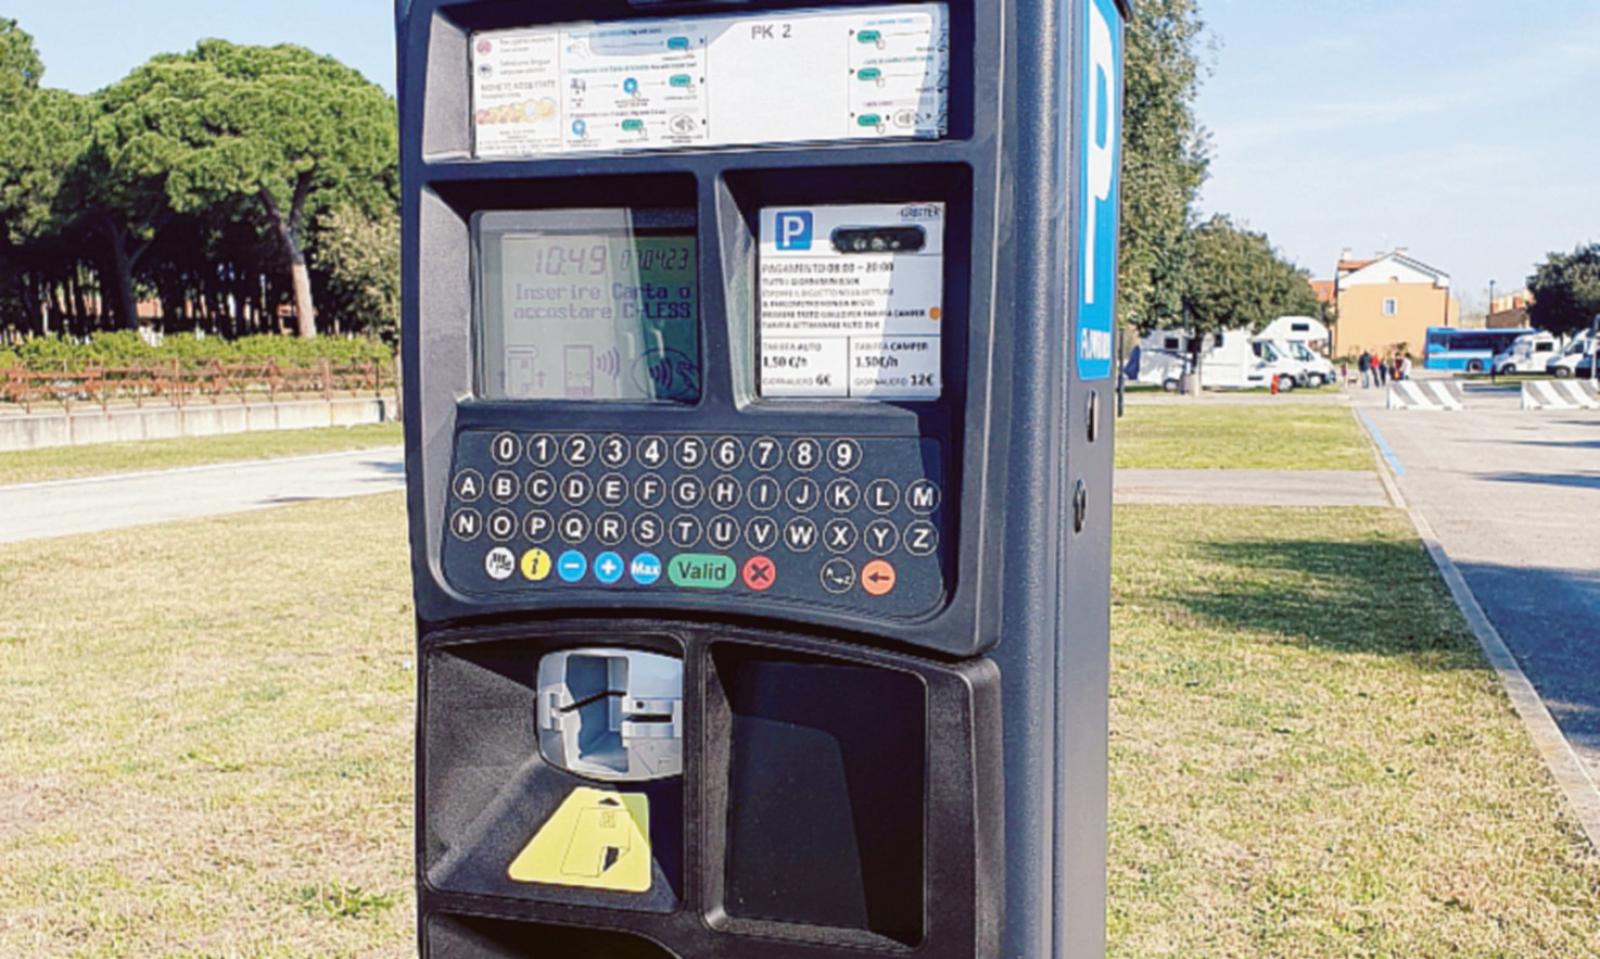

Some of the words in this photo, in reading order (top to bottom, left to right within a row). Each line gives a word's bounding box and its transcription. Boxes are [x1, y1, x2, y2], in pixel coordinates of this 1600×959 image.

[751, 24, 774, 40] PK
[782, 23, 792, 39] 2
[1084, 0, 1115, 305] P
[783, 216, 805, 247] P
[515, 283, 601, 301] Inserire
[612, 281, 669, 300] Carta
[678, 286, 691, 300] o
[513, 303, 613, 320] accostare
[623, 302, 692, 320] C-LESS
[890, 342, 928, 351] CAMPER
[815, 374, 831, 385] 6€
[910, 375, 934, 386] 12€
[536, 438, 547, 461] 1
[571, 439, 586, 461] 2
[607, 439, 623, 462] 3
[644, 440, 660, 463] 4
[682, 441, 697, 463] 5
[719, 441, 735, 465] 6
[758, 442, 774, 465] 7
[797, 442, 812, 466] 8
[837, 443, 852, 467] 9
[460, 476, 476, 495] A
[496, 478, 511, 496] B
[533, 479, 548, 498] C
[569, 479, 584, 498] D
[605, 480, 621, 499] E
[643, 481, 657, 500] F
[679, 482, 696, 501] G
[717, 483, 734, 502] H
[760, 484, 767, 503] I
[796, 485, 809, 504] J
[835, 485, 851, 506] K
[876, 487, 890, 506] L
[913, 487, 933, 507] M
[458, 515, 474, 533] N
[494, 516, 511, 535] O
[531, 517, 546, 535] P
[565, 518, 583, 538] Q
[603, 519, 619, 539] R
[640, 520, 655, 539] S
[678, 521, 693, 541] T
[715, 522, 732, 542] U
[754, 524, 770, 544] V
[790, 526, 813, 545] W
[832, 526, 848, 546] X
[873, 528, 889, 547] Y
[913, 528, 929, 548] Z
[631, 560, 660, 576] Max
[678, 561, 727, 581] Valid
